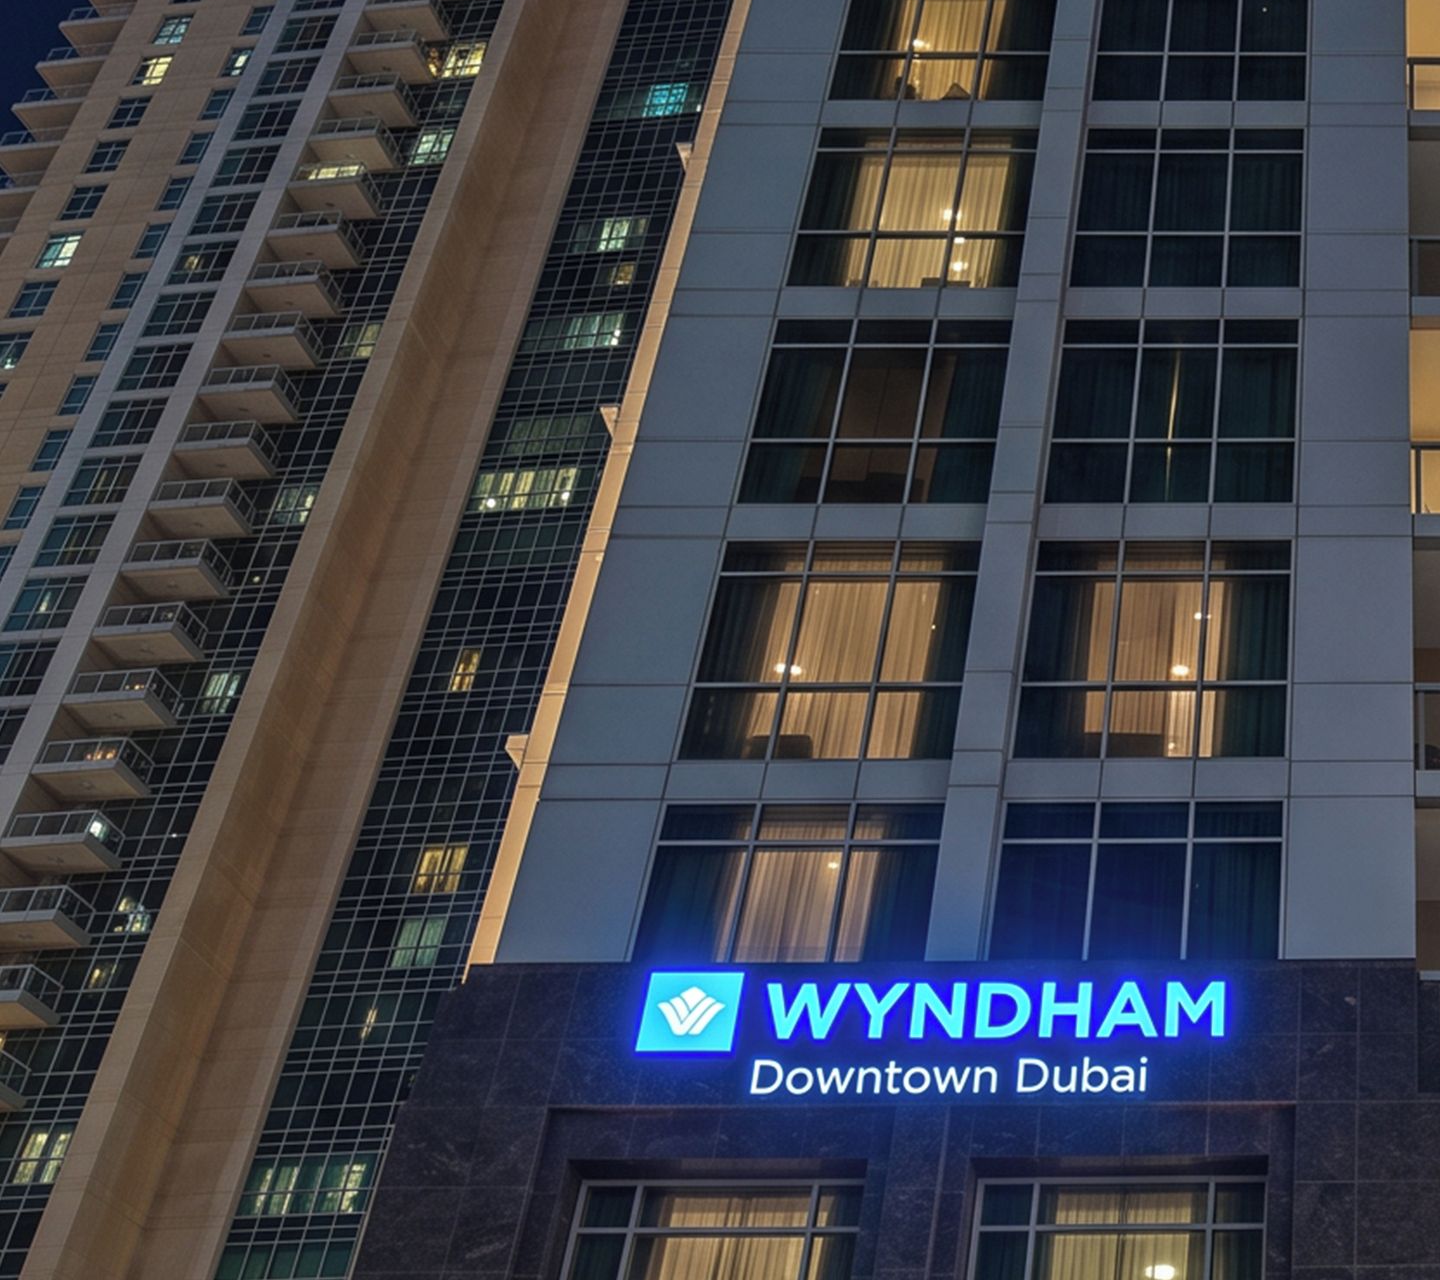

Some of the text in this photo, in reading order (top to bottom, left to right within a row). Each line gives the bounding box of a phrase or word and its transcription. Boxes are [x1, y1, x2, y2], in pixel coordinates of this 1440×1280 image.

[766, 980, 1225, 1040] WYNDHAM
[749, 1056, 1148, 1095] Downtown Dubai
